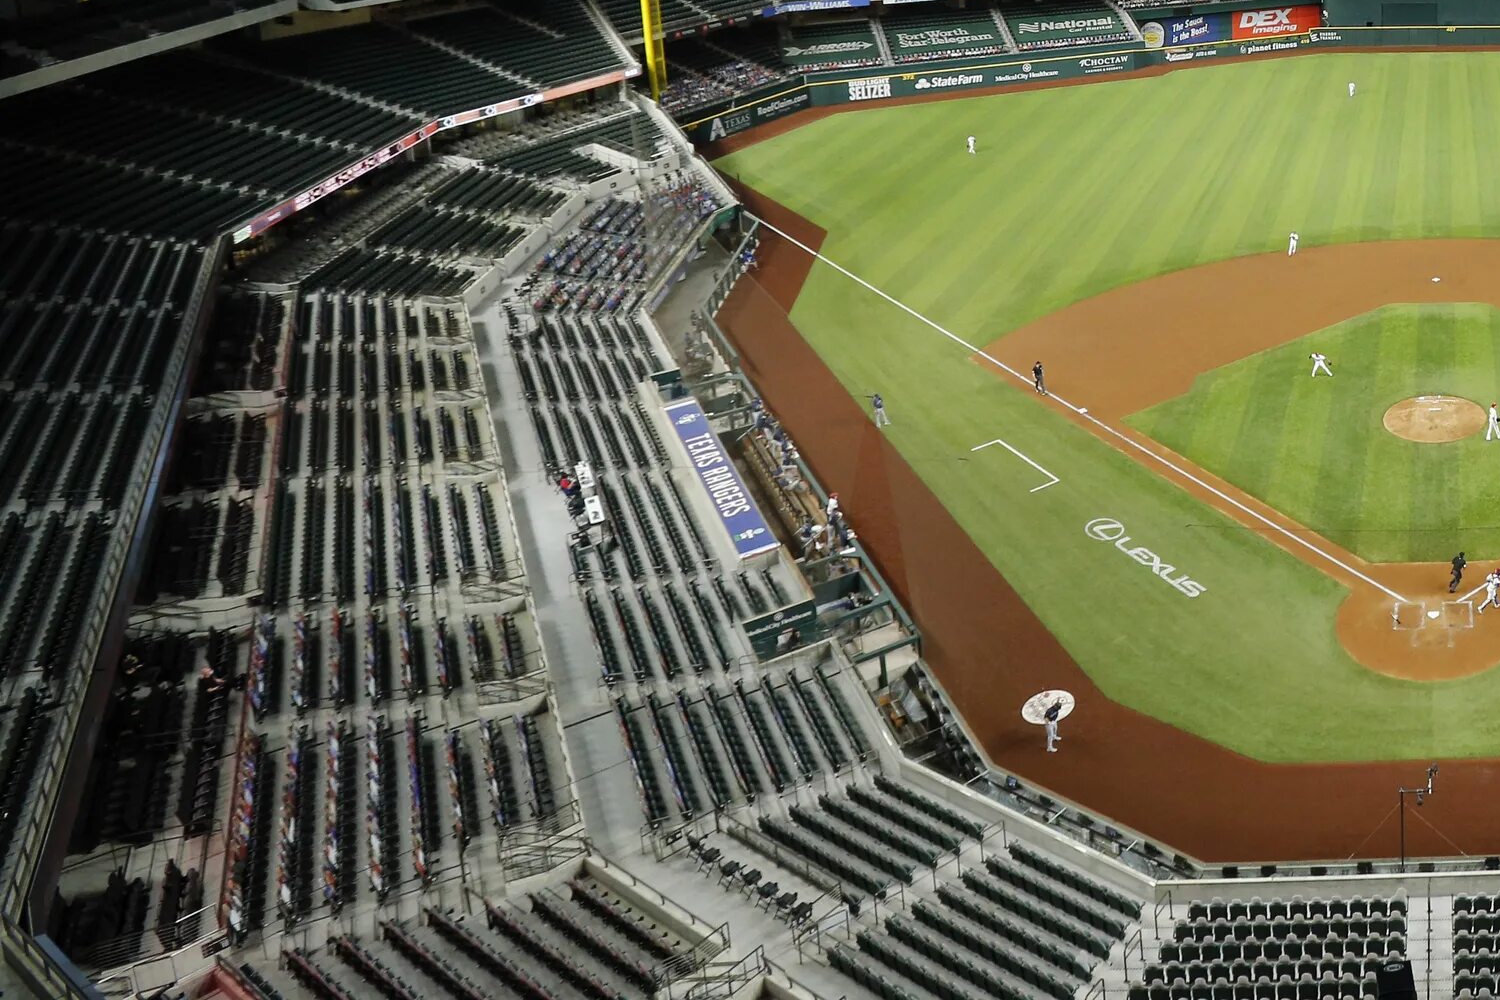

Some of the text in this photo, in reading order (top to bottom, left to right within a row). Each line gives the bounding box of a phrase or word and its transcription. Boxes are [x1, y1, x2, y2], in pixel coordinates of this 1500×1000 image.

[1042, 17, 1113, 31] National
[1240, 8, 1292, 28] DEX
[1172, 22, 1184, 32] The
[897, 27, 968, 42] Fort Worth
[1172, 35, 1179, 43] is
[1180, 32, 1189, 40] the
[1247, 40, 1297, 54] planet fitness
[1083, 56, 1129, 67] CHOCTAW
[868, 78, 889, 86] LIGHT
[1018, 73, 1029, 82] City
[1029, 69, 1058, 78] Healthcare
[849, 83, 892, 100] SELTZER
[725, 113, 750, 129] TEXAS
[684, 432, 750, 518] TEXAS RANGERS
[1115, 536, 1208, 598] LEXUS
